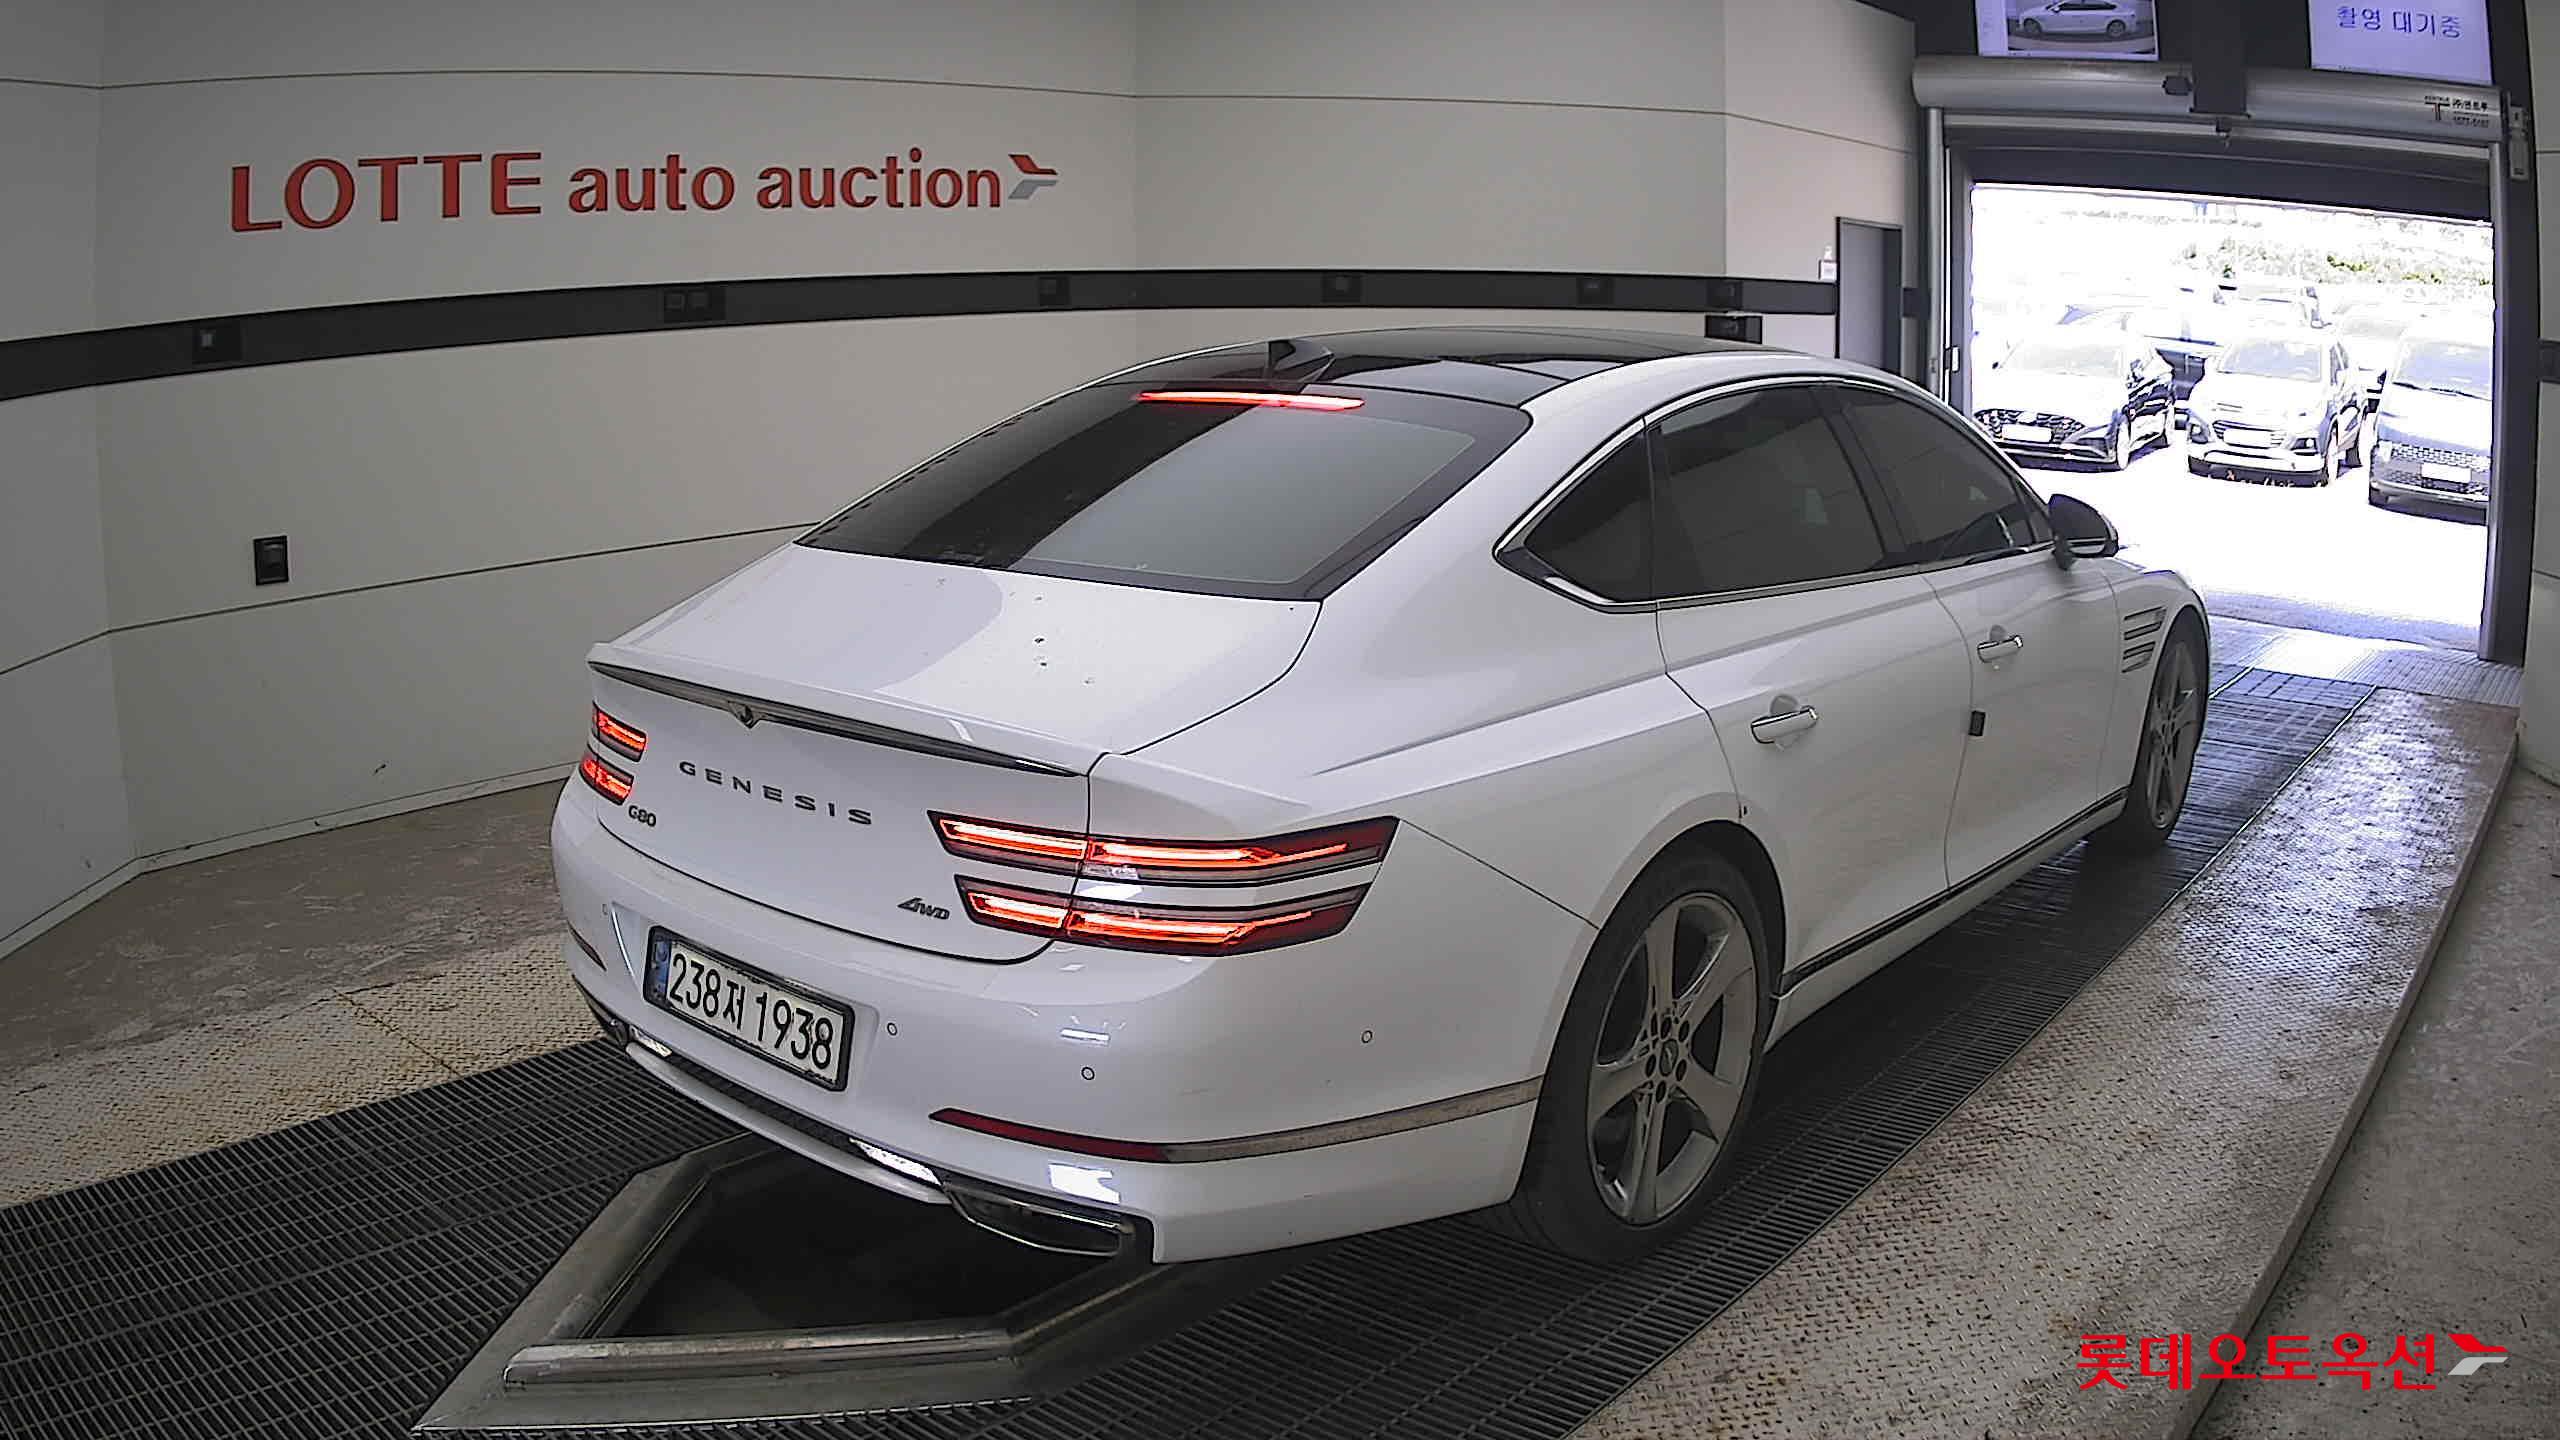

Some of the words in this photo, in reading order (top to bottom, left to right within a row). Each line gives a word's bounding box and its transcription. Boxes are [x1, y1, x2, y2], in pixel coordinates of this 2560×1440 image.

[2336, 6, 2381, 31] 촬영
[2392, 11, 2461, 39] 대기중
[231, 152, 541, 232] LOTTE
[569, 154, 735, 211] auto
[757, 148, 1001, 208] auction
[628, 804, 657, 827] G80
[679, 760, 872, 826] GENESIS
[755, 991, 834, 1070] 1938
